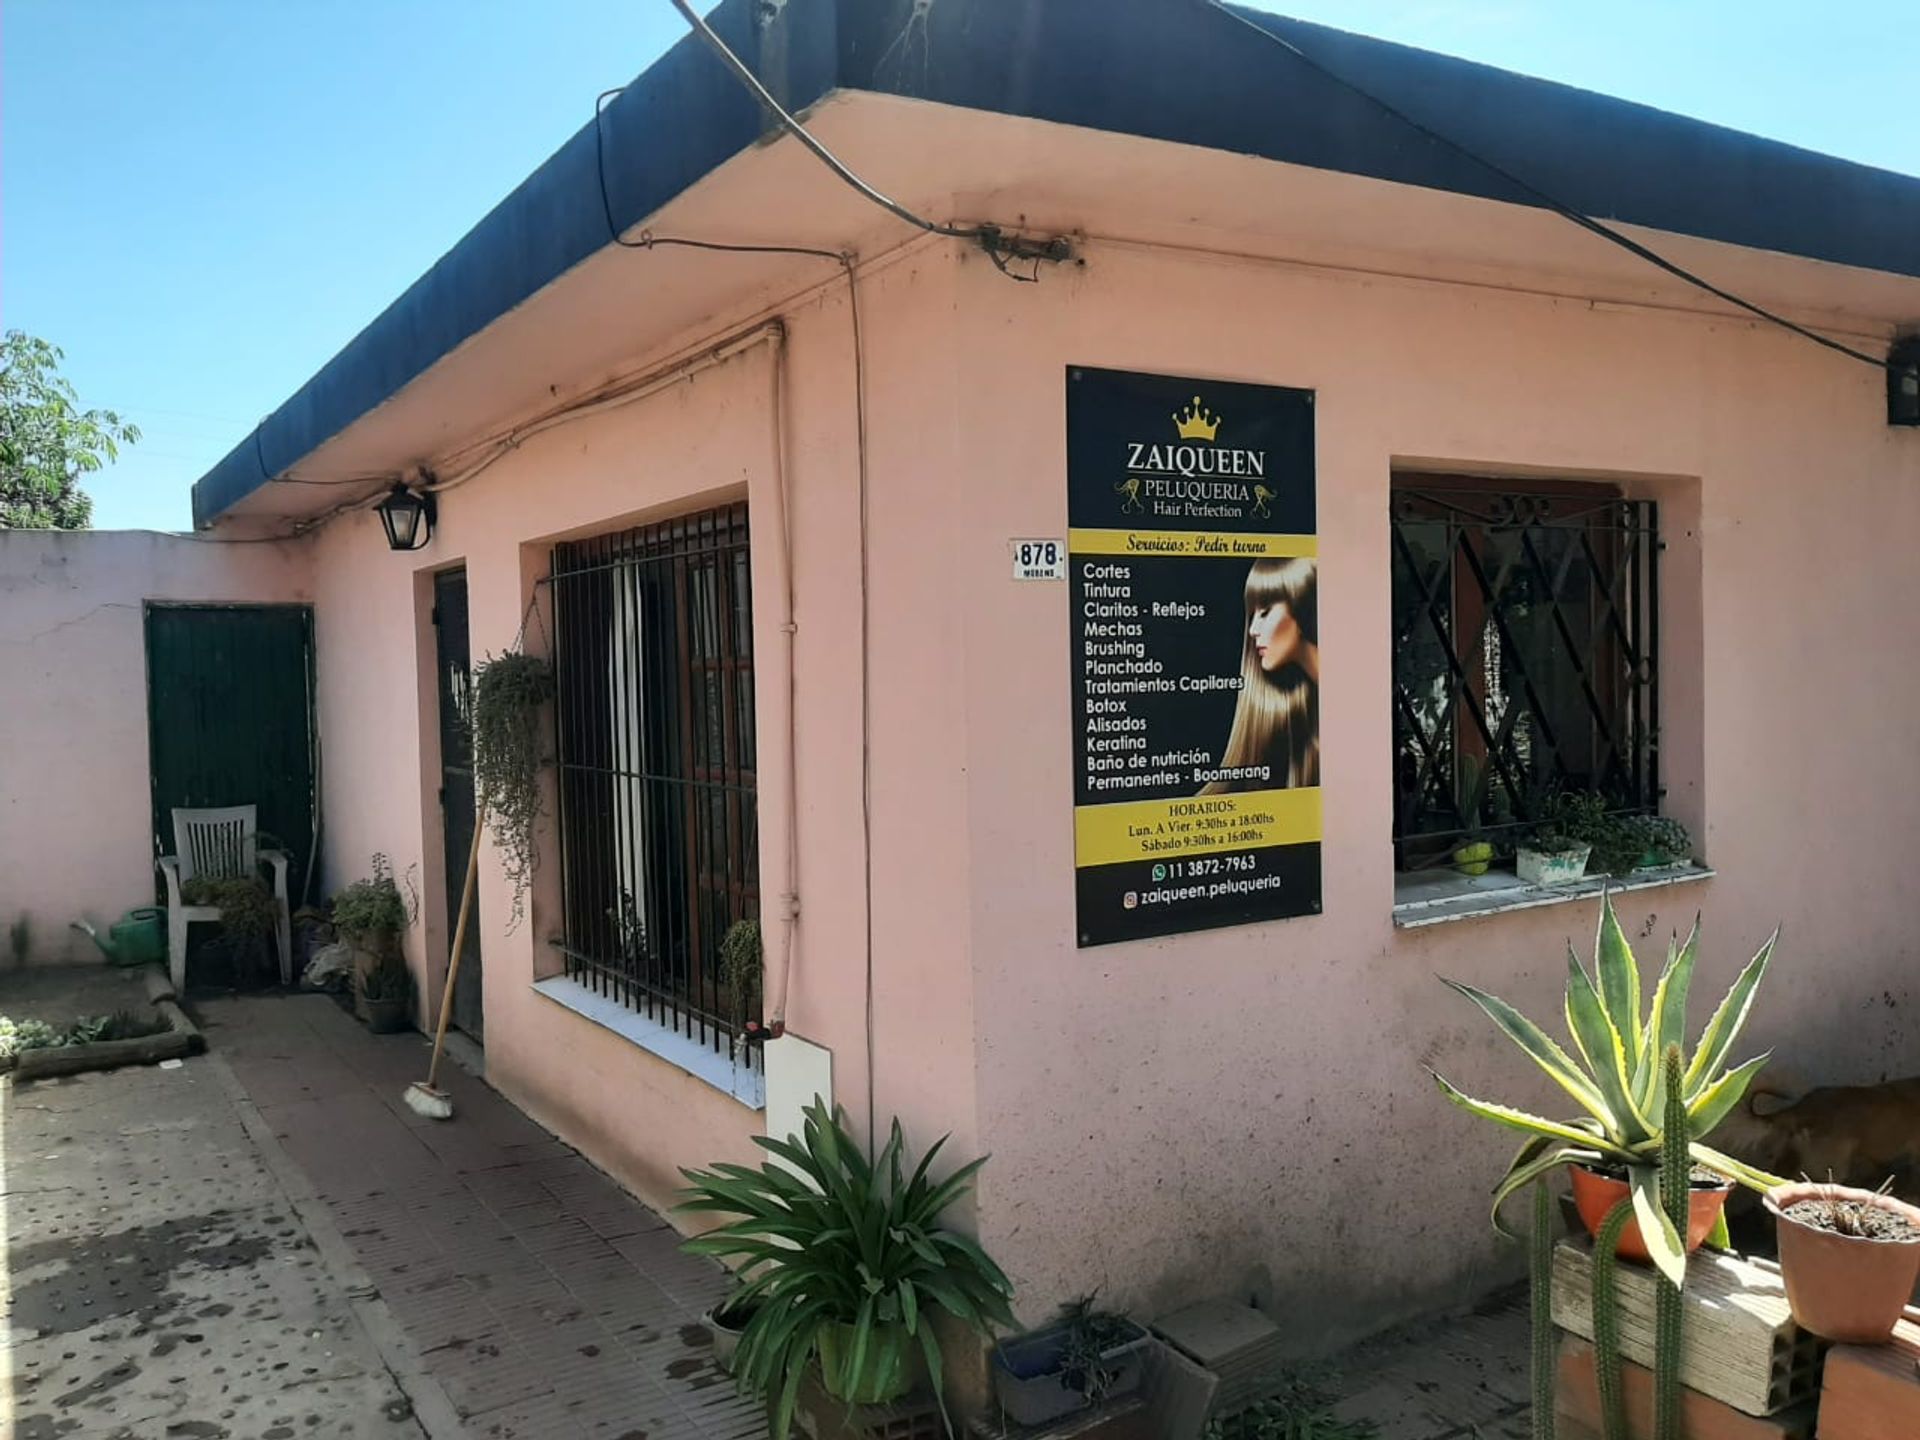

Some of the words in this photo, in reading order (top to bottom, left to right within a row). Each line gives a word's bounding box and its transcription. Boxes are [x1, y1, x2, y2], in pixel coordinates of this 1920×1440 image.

[1127, 443, 1265, 477] ZAIQUEEN
[1145, 480, 1249, 501] PELUQUERIA
[1154, 501, 1181, 516] Hair
[1185, 502, 1242, 518] Perfection
[1127, 534, 1189, 551] Servicios:
[1194, 537, 1228, 552] Pedir
[1233, 539, 1267, 553] turno
[1021, 543, 1056, 566] 878
[1083, 562, 1131, 579] Cortes
[1083, 583, 1131, 598] Tintura
[1084, 602, 1138, 618] Claritos
[1152, 602, 1205, 620] Reflejos
[1084, 621, 1143, 636] Mechas
[1085, 641, 1144, 658] Brushing
[1085, 660, 1163, 675] Planchado
[1085, 678, 1175, 694] Tratamientos
[1179, 676, 1244, 692] Capilares
[1086, 699, 1127, 713] Botox
[1086, 717, 1147, 733] Alisados
[1087, 736, 1147, 752] Keratina
[1087, 755, 1125, 771] Baño
[1128, 753, 1147, 768] de
[1151, 748, 1211, 767] nutrición
[1088, 771, 1180, 790] Permanentes
[1194, 766, 1270, 783] Boomerang
[1169, 800, 1237, 817] HORARIOS:
[1129, 825, 1153, 837] Lun.
[1156, 823, 1165, 834] A
[1168, 820, 1193, 832] Vier.
[1196, 816, 1228, 830] 9:30hs
[1230, 818, 1236, 826] a
[1239, 812, 1275, 826] 18:00hs
[1183, 834, 1217, 847] 9:30hs
[1218, 835, 1225, 843] a
[1228, 829, 1263, 843] 16:00hs
[1170, 863, 1183, 879] 11
[1188, 855, 1256, 877] 3872-7963
[1141, 874, 1281, 904] zaiqueen.peluqueria
